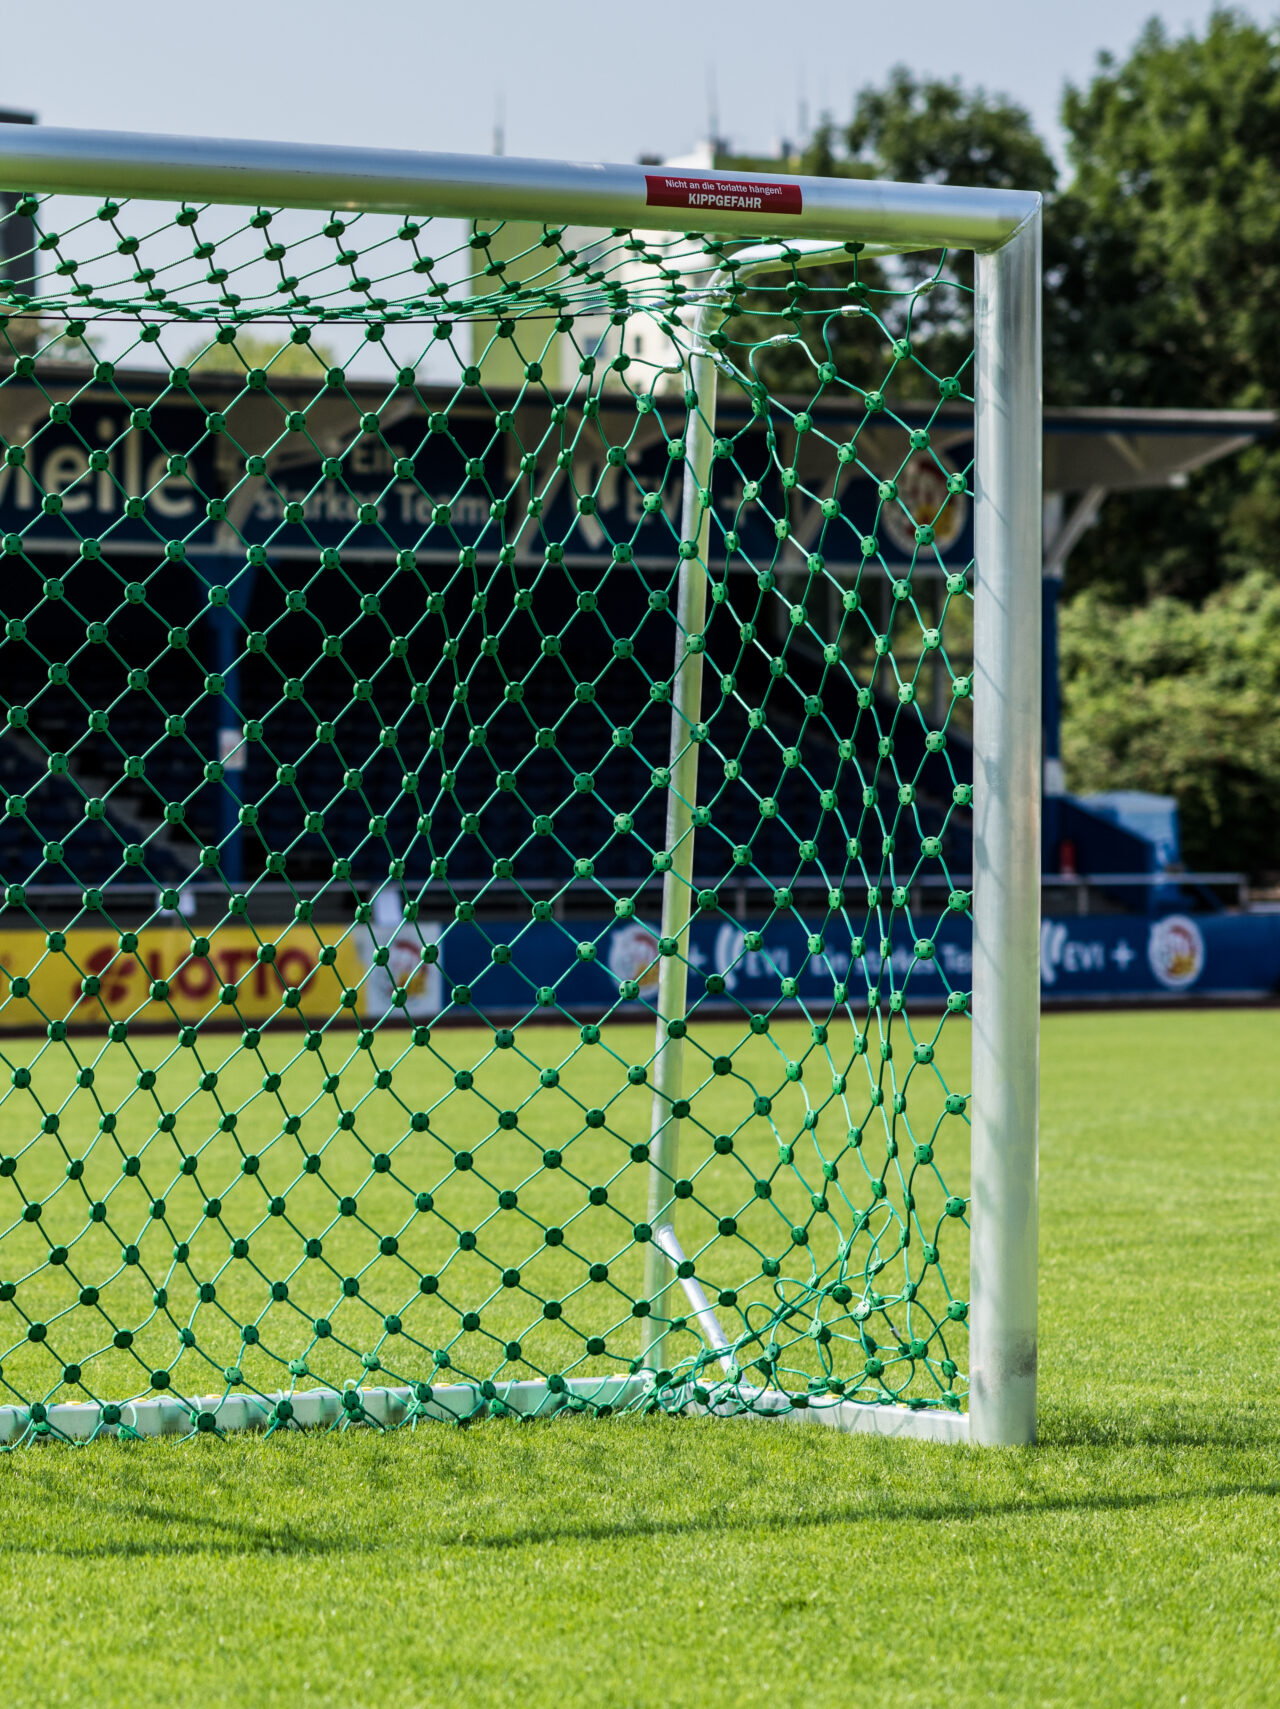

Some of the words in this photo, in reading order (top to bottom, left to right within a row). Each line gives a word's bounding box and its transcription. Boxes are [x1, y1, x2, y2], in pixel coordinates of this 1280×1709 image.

[665, 179, 688, 189] Nicht
[689, 182, 700, 190] an
[701, 181, 715, 191] die
[716, 182, 748, 193] Torlatte
[749, 185, 783, 196] hängen!
[688, 193, 762, 209] KIPPGEFAHR
[149, 947, 316, 1002] LOTTO
